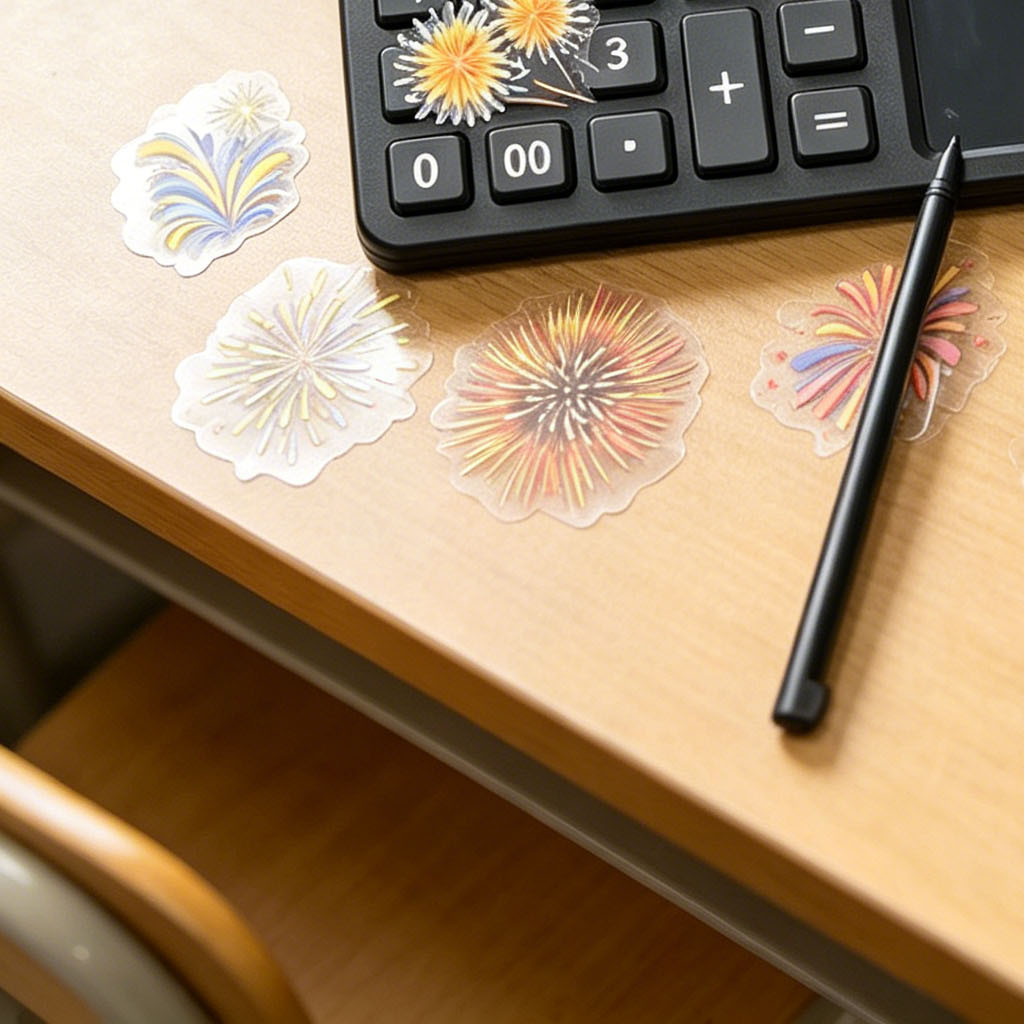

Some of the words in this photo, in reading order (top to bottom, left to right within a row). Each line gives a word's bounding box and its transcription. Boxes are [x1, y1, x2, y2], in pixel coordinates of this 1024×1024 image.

[605, 36, 629, 71] 3
[412, 152, 439, 189] 0
[503, 139, 552, 178] 00
